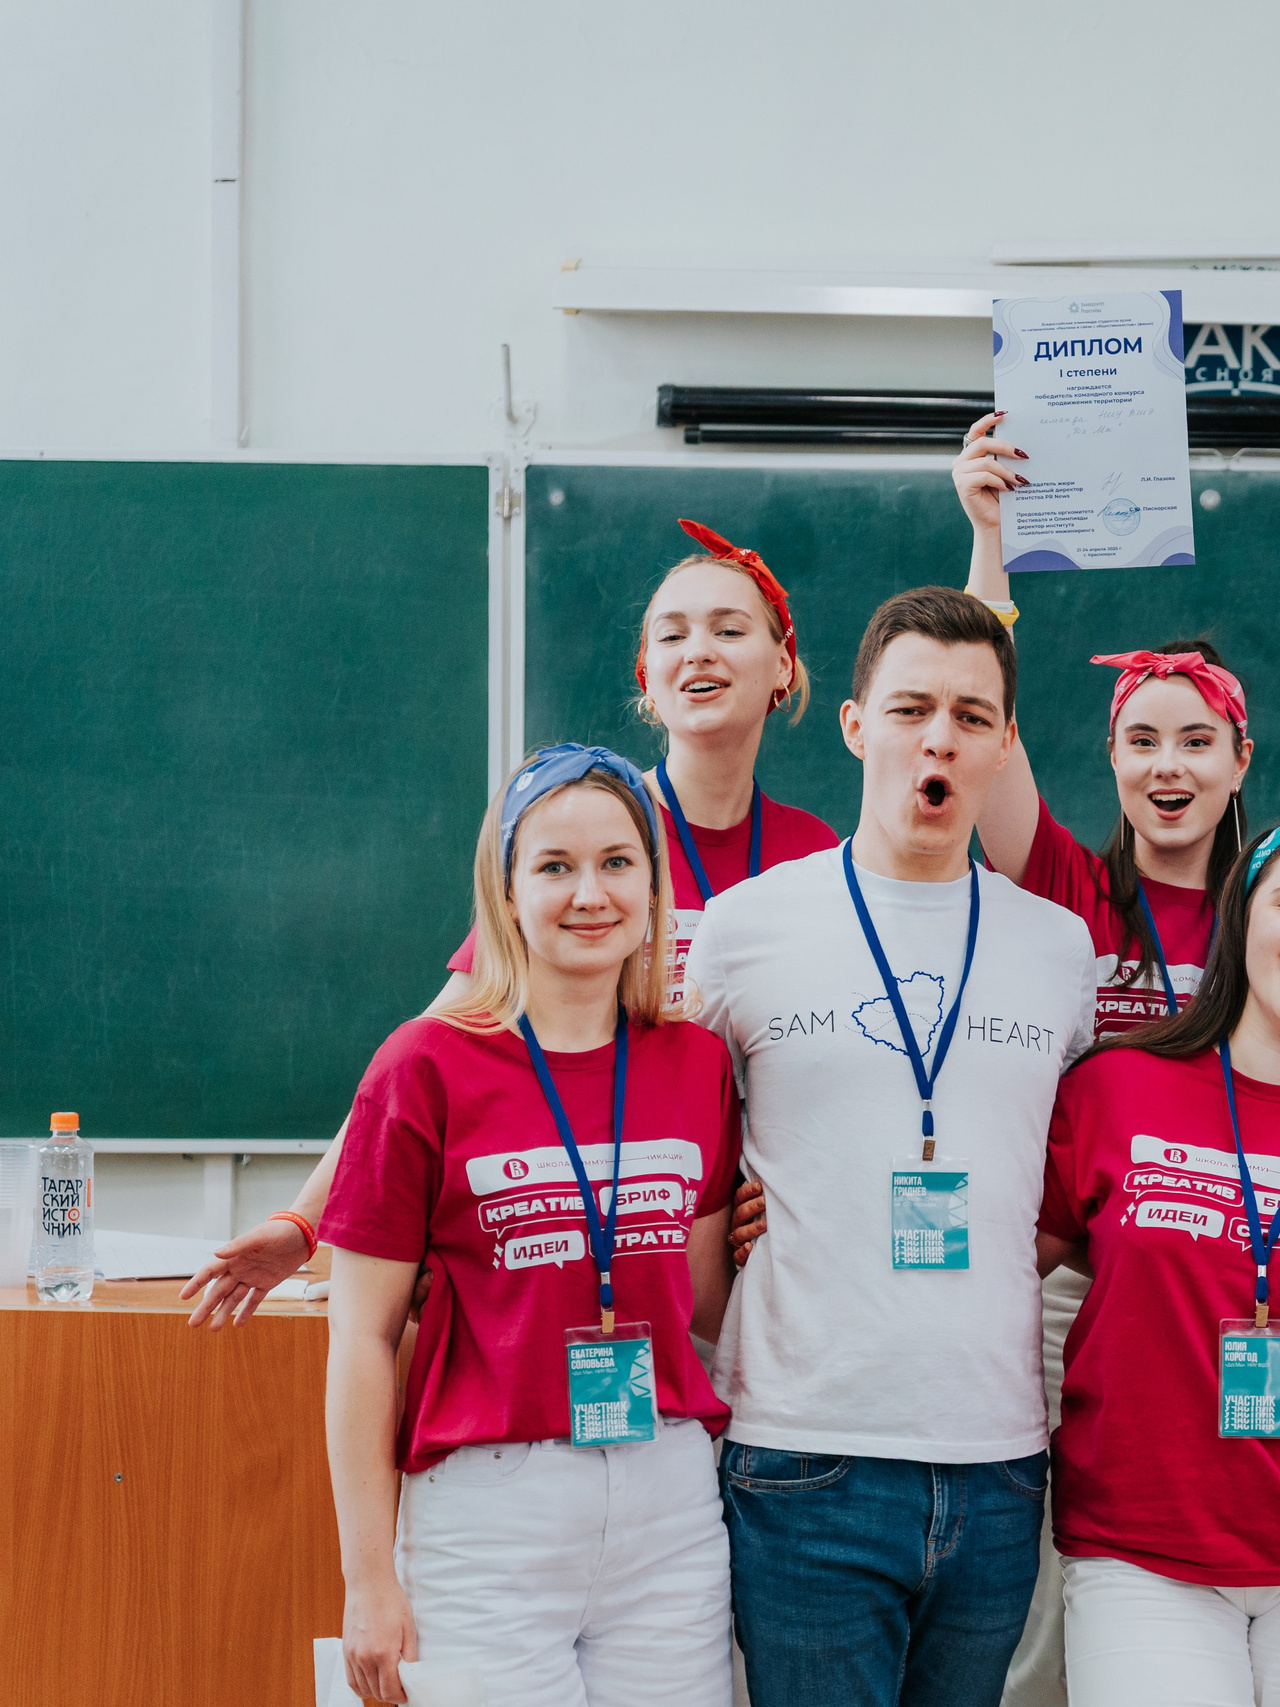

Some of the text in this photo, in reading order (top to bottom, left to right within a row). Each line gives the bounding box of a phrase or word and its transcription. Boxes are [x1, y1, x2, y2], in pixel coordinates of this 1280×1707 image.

[1034, 337, 1142, 362] ДИПЛОМ
[1066, 368, 1117, 378] степени
[1067, 384, 1112, 392] награждается
[1114, 389, 1144, 397] конкурса
[1096, 1001, 1183, 1016] КРЕАТИ
[768, 1009, 1054, 1055] SAM HEART
[537, 1160, 570, 1169] ШКОЛА
[1195, 1157, 1229, 1168] ШКОЛА
[42, 1177, 83, 1194] ТАГАР
[894, 1176, 922, 1186] НИКИТА
[1133, 1174, 1236, 1200] КРЕАТИВ
[894, 1187, 927, 1197] ГРИДНЕВ
[42, 1193, 80, 1207] СКИЙ
[486, 1195, 585, 1223] КРЕАТИВ
[615, 1188, 671, 1206] БРИФ
[42, 1208, 80, 1222] ИСТО
[1147, 1208, 1208, 1227] ИДЕИ
[42, 1222, 81, 1236] ЧНИК
[894, 1229, 945, 1241] УЧАСТНИК
[513, 1230, 686, 1261] ИДЕИ ТРАТЕ
[1225, 1341, 1247, 1351] ЮЛИЯ
[571, 1347, 614, 1359] ЕКАТЕРИНА
[1225, 1352, 1258, 1363] КОРОГОД
[571, 1358, 615, 1370] СОЛОВЬЕВА
[1224, 1395, 1275, 1407] УЧАСТНИК
[574, 1401, 628, 1415] УЧАСТНИК
